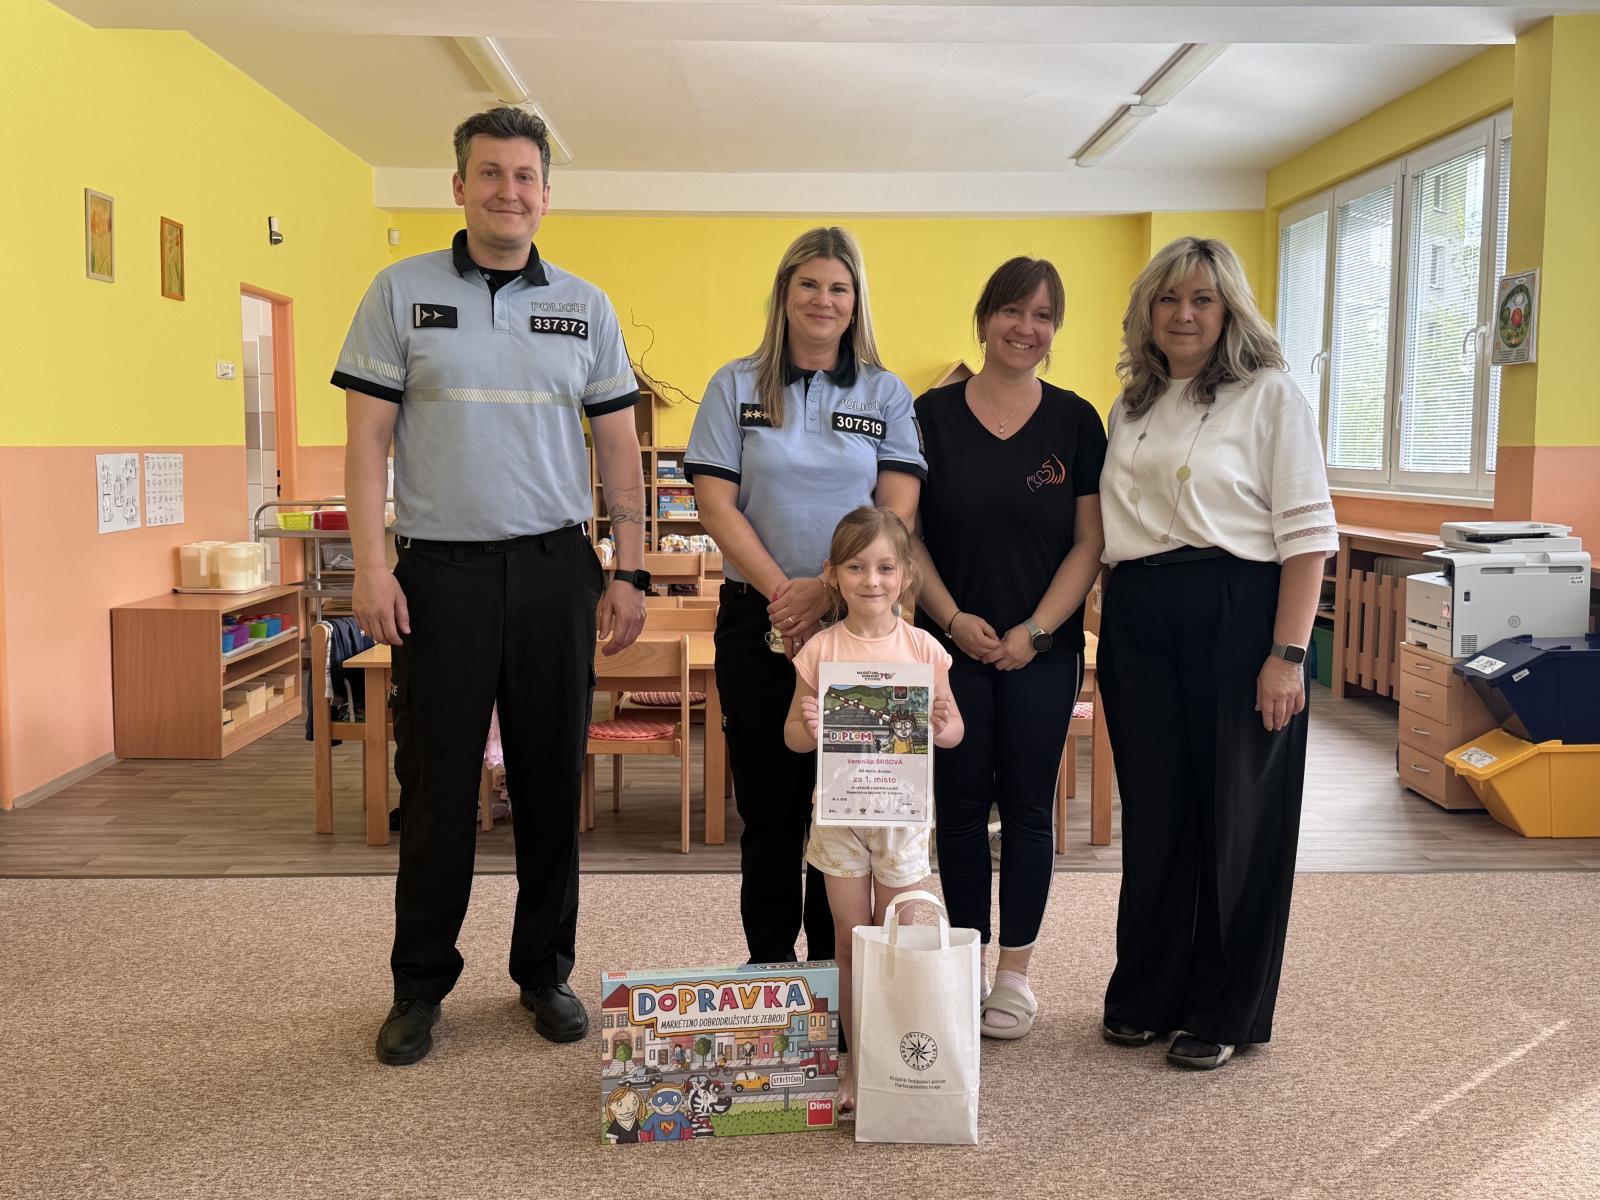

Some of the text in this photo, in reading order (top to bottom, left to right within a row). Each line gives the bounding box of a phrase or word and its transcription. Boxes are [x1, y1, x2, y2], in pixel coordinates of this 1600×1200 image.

[530, 301, 586, 314] POLICIE
[534, 318, 586, 335] 337372
[836, 415, 882, 435] 307519
[831, 731, 873, 742] DIPLOM
[865, 775, 872, 783] 1.
[638, 983, 805, 1016] DOPRAVKA
[698, 1014, 751, 1027] DOBRODRUŽSTVÍ
[751, 1015, 760, 1024] SE
[760, 1014, 785, 1024] ZEBROU
[809, 1101, 831, 1110] Dino
